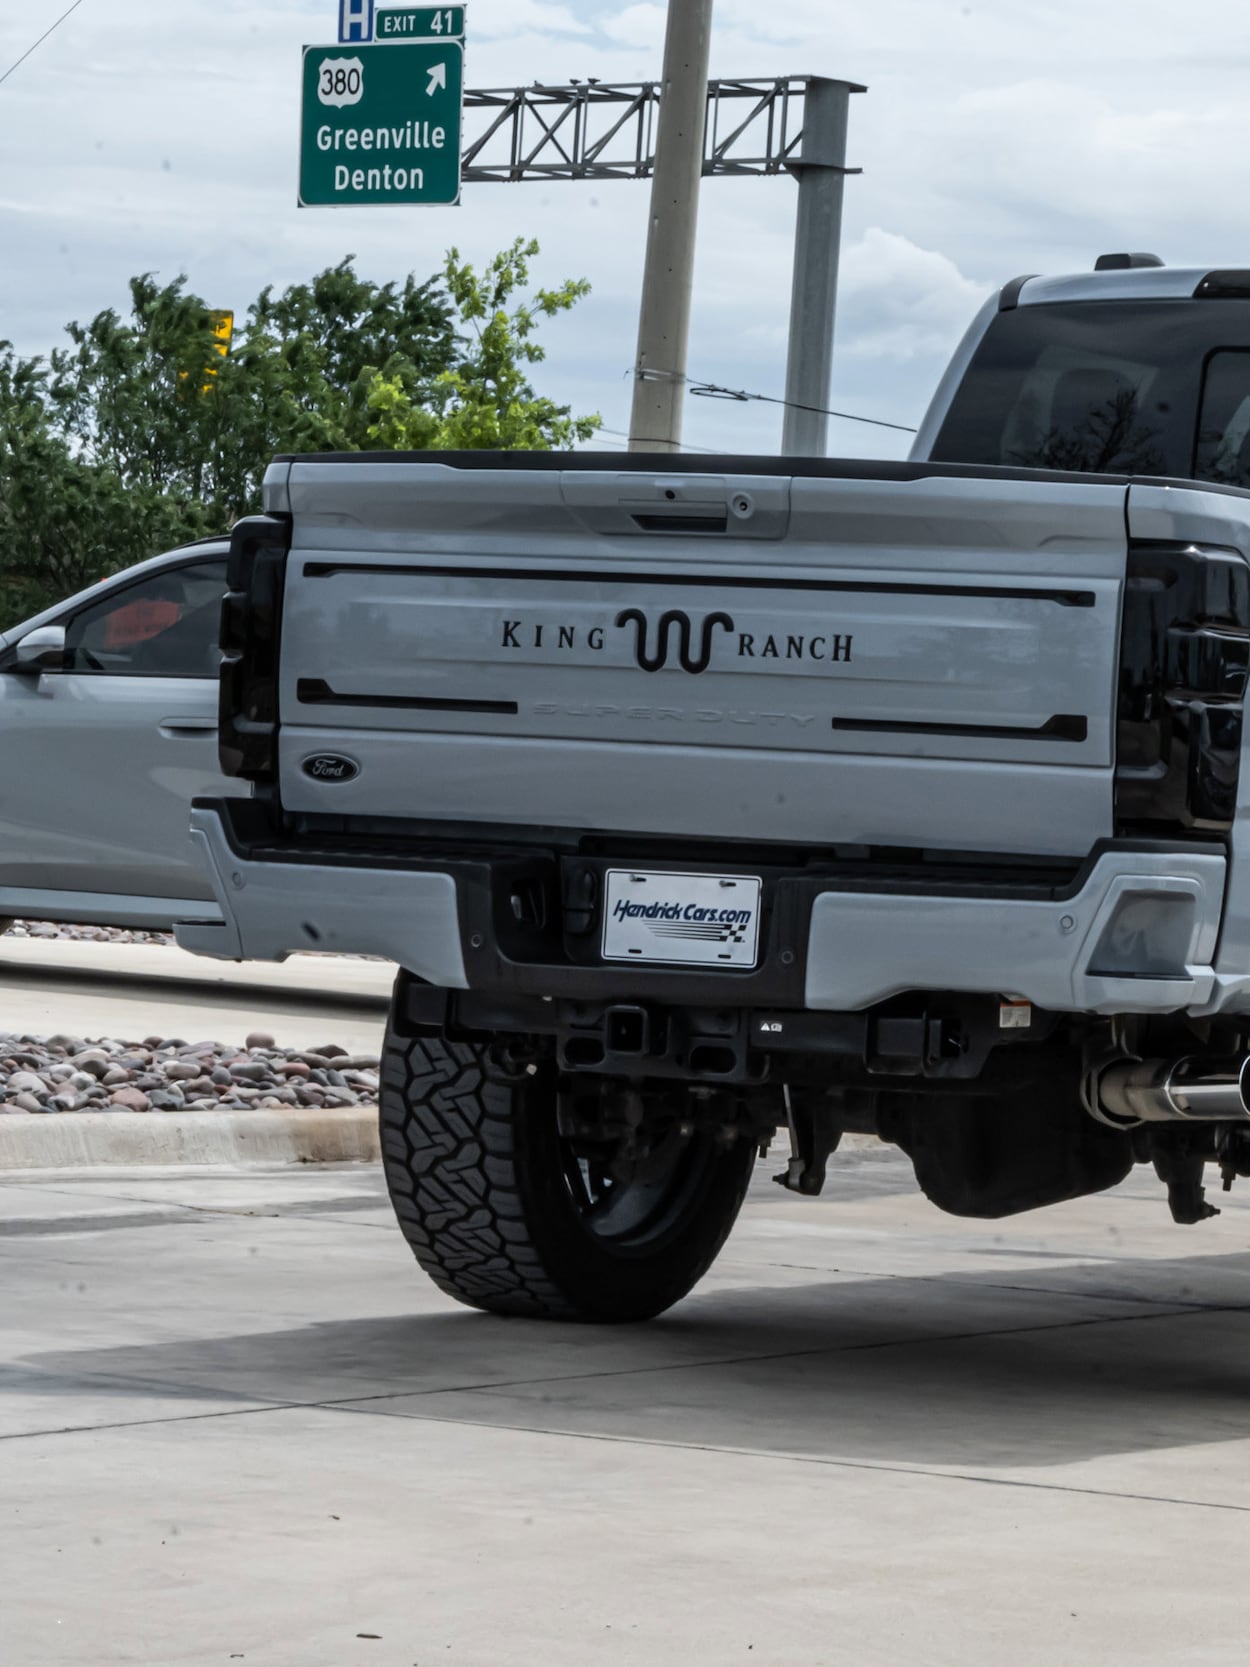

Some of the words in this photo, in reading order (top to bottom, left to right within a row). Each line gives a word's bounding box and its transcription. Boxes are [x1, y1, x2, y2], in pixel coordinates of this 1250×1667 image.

[342, 0, 369, 40] H
[384, 15, 416, 33] EXIT
[430, 10, 453, 34] 41
[321, 68, 361, 96] 380
[317, 121, 446, 150] Greenville
[334, 164, 424, 191] Denton
[501, 620, 605, 650] KING
[737, 633, 854, 663] RANCH
[533, 703, 684, 722] SUPER
[696, 708, 816, 728] DUTY
[312, 758, 345, 777] Ford
